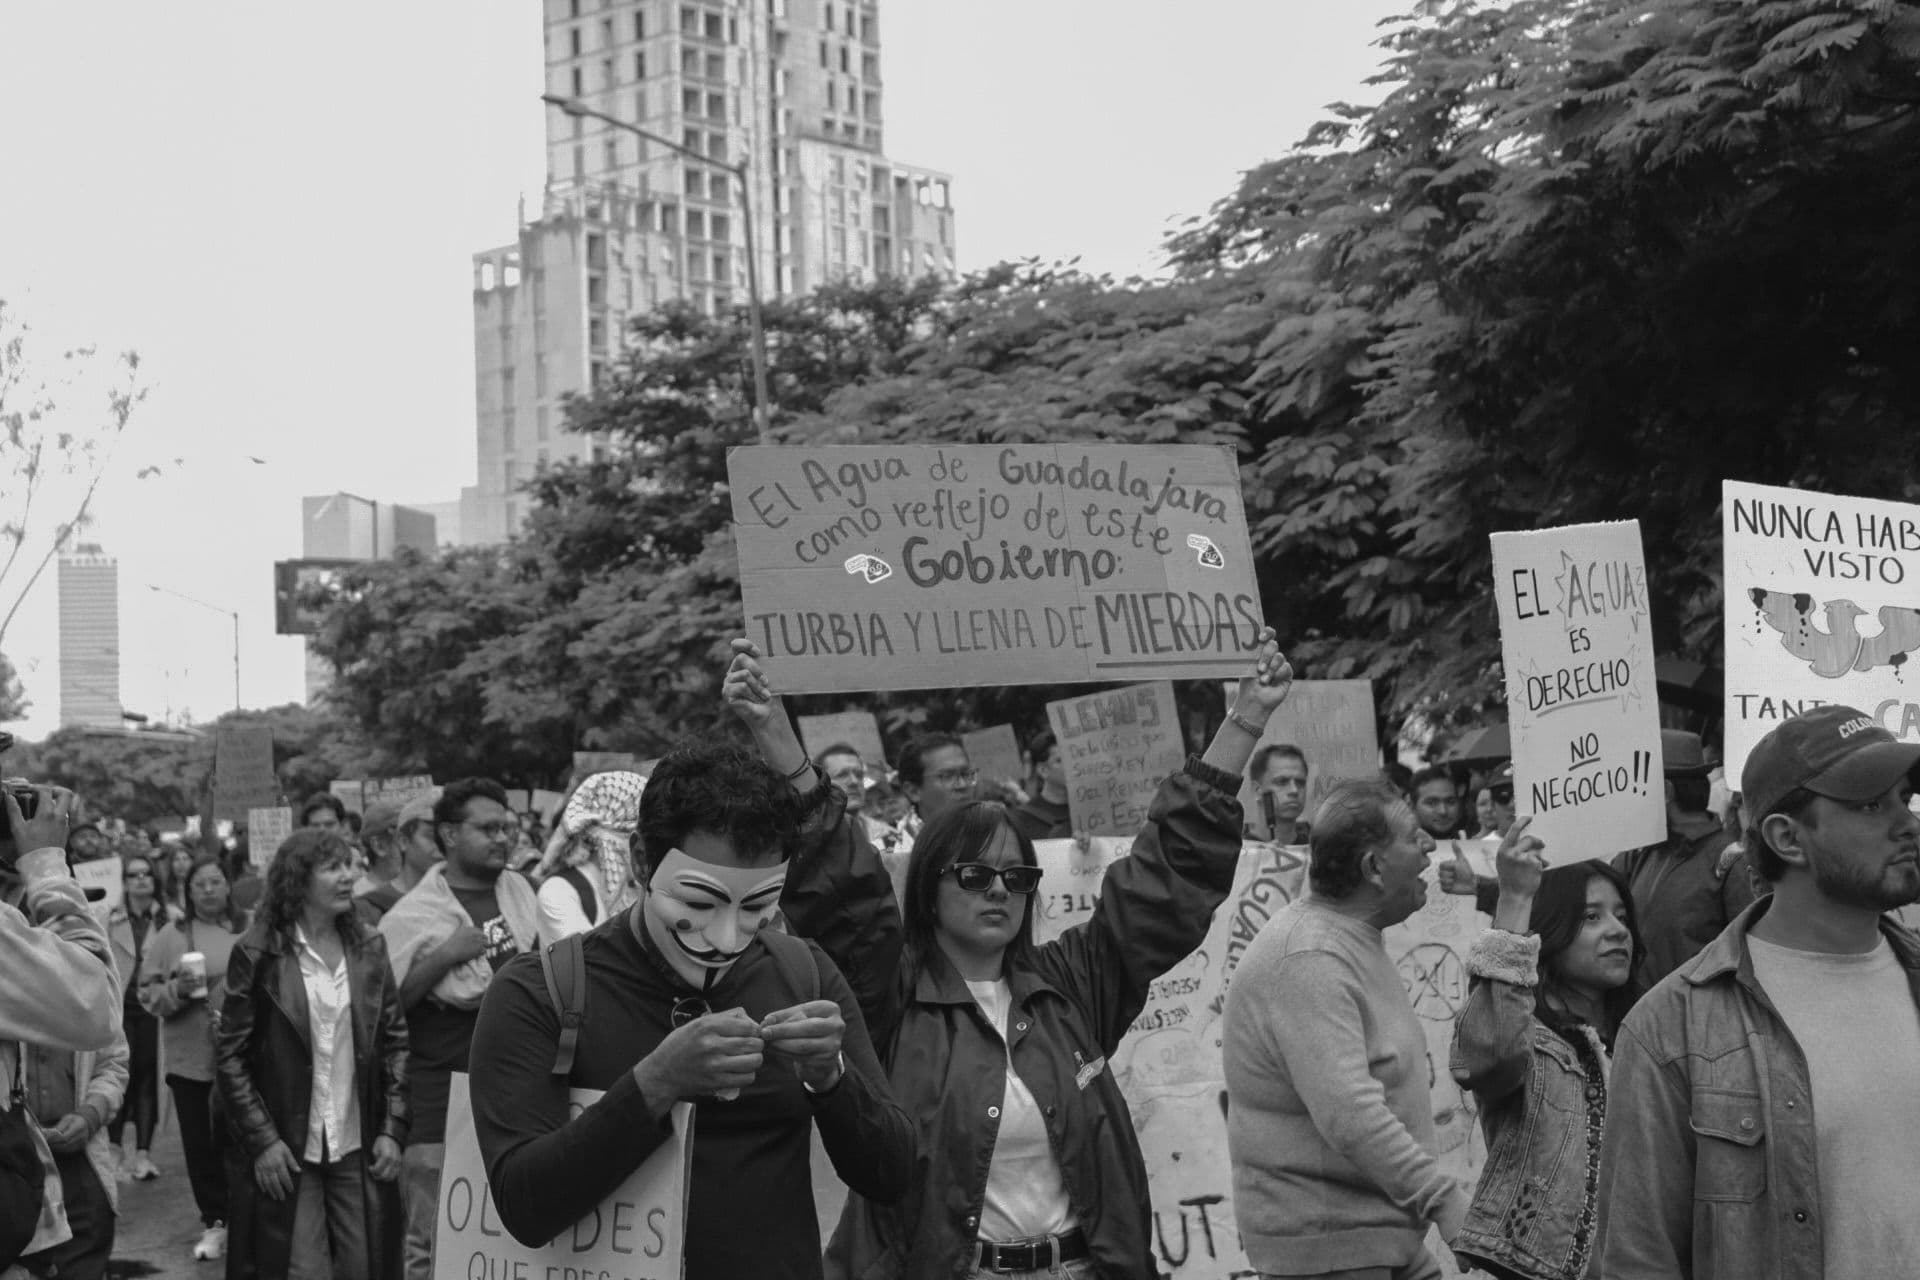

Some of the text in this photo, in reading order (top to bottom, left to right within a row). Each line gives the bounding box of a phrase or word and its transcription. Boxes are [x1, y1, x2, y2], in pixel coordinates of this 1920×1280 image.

[747, 448, 1229, 529] El Agua de Guadalajara
[795, 487, 1173, 564] como reflejo de este
[1733, 498, 1920, 552] NUNCA HAB
[902, 535, 1124, 588] Gobierno:
[1803, 547, 1905, 585] VISTO
[1512, 560, 1639, 620] EL AGUA
[753, 590, 1260, 657] TURBIA Y LLENA DE MIERDAS
[1568, 627, 1591, 654] ES
[1526, 657, 1630, 712] DERECHO
[1569, 732, 1600, 763] NO
[447, 1176, 666, 1259] OLDES
